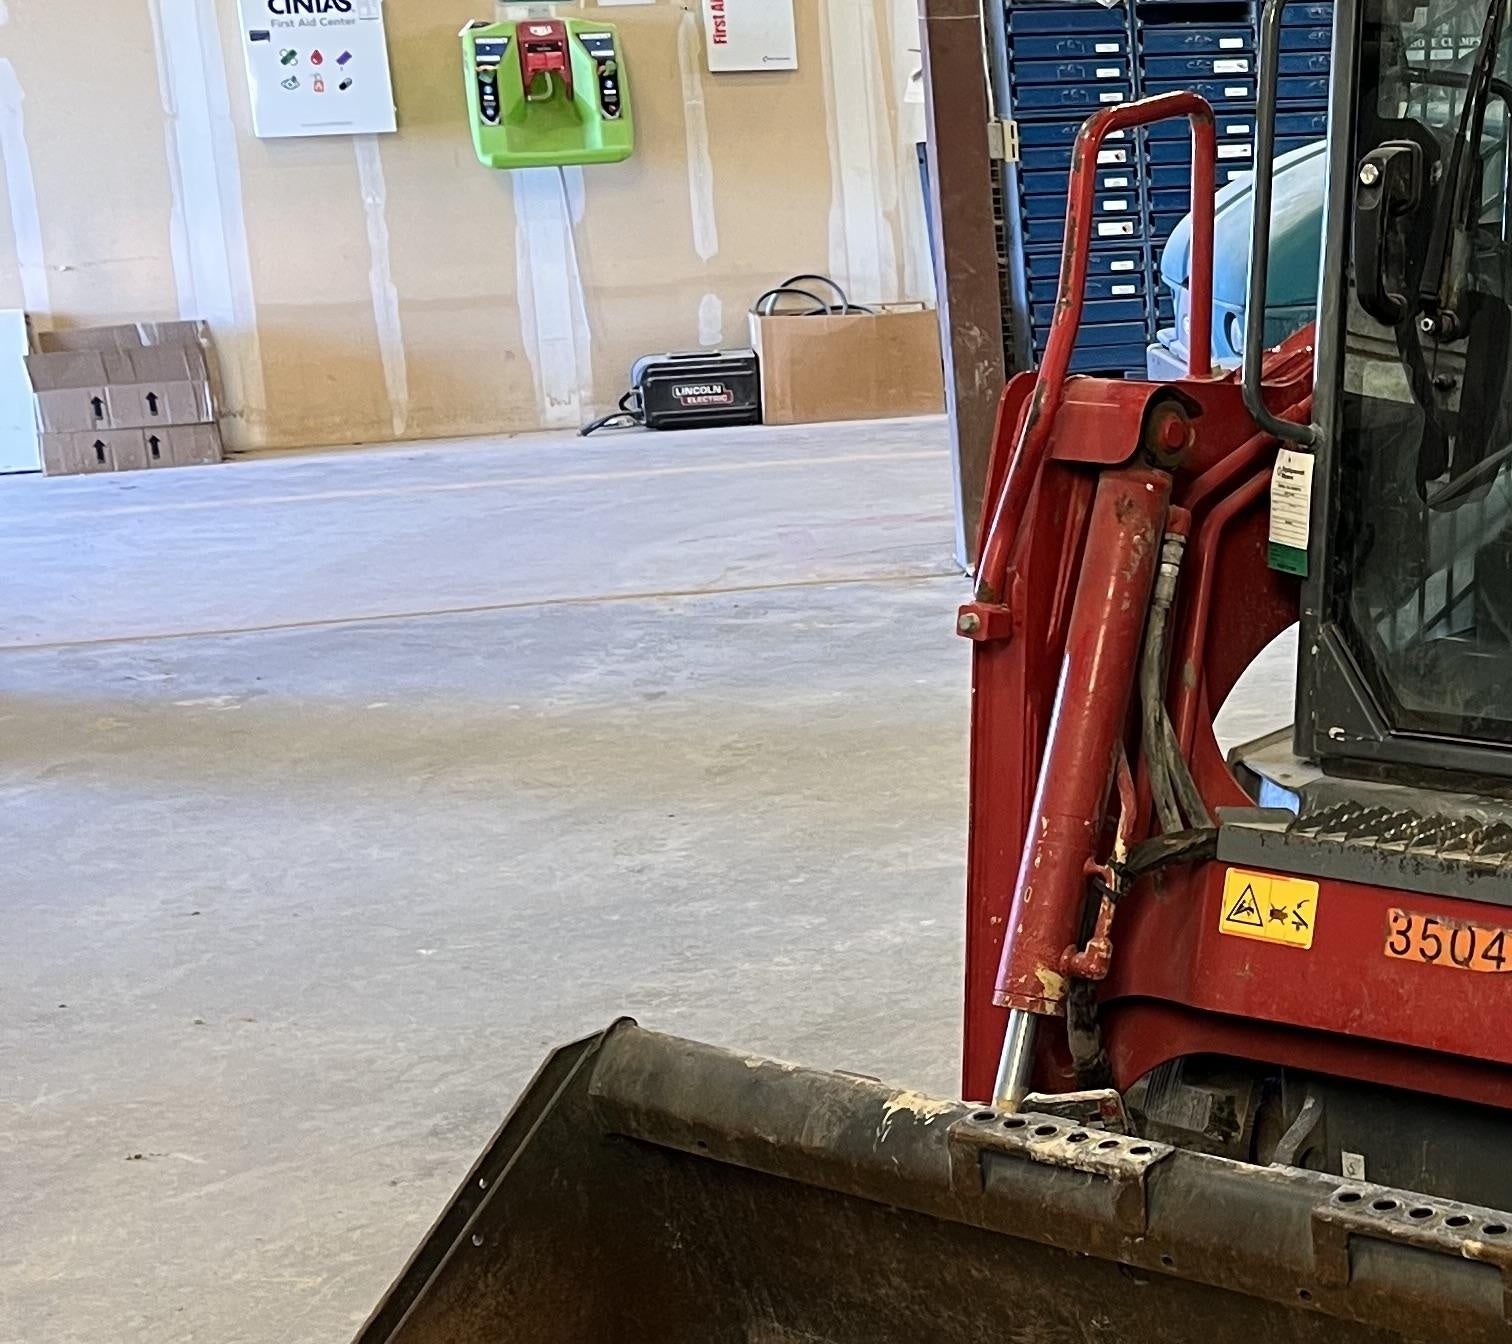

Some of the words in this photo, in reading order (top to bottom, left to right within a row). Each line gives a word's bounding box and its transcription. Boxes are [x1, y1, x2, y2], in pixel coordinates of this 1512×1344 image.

[270, 18, 295, 29] First
[298, 17, 317, 27] Aid
[319, 16, 356, 27] Center
[712, 14, 728, 44] First
[675, 385, 722, 396] LINCOLN
